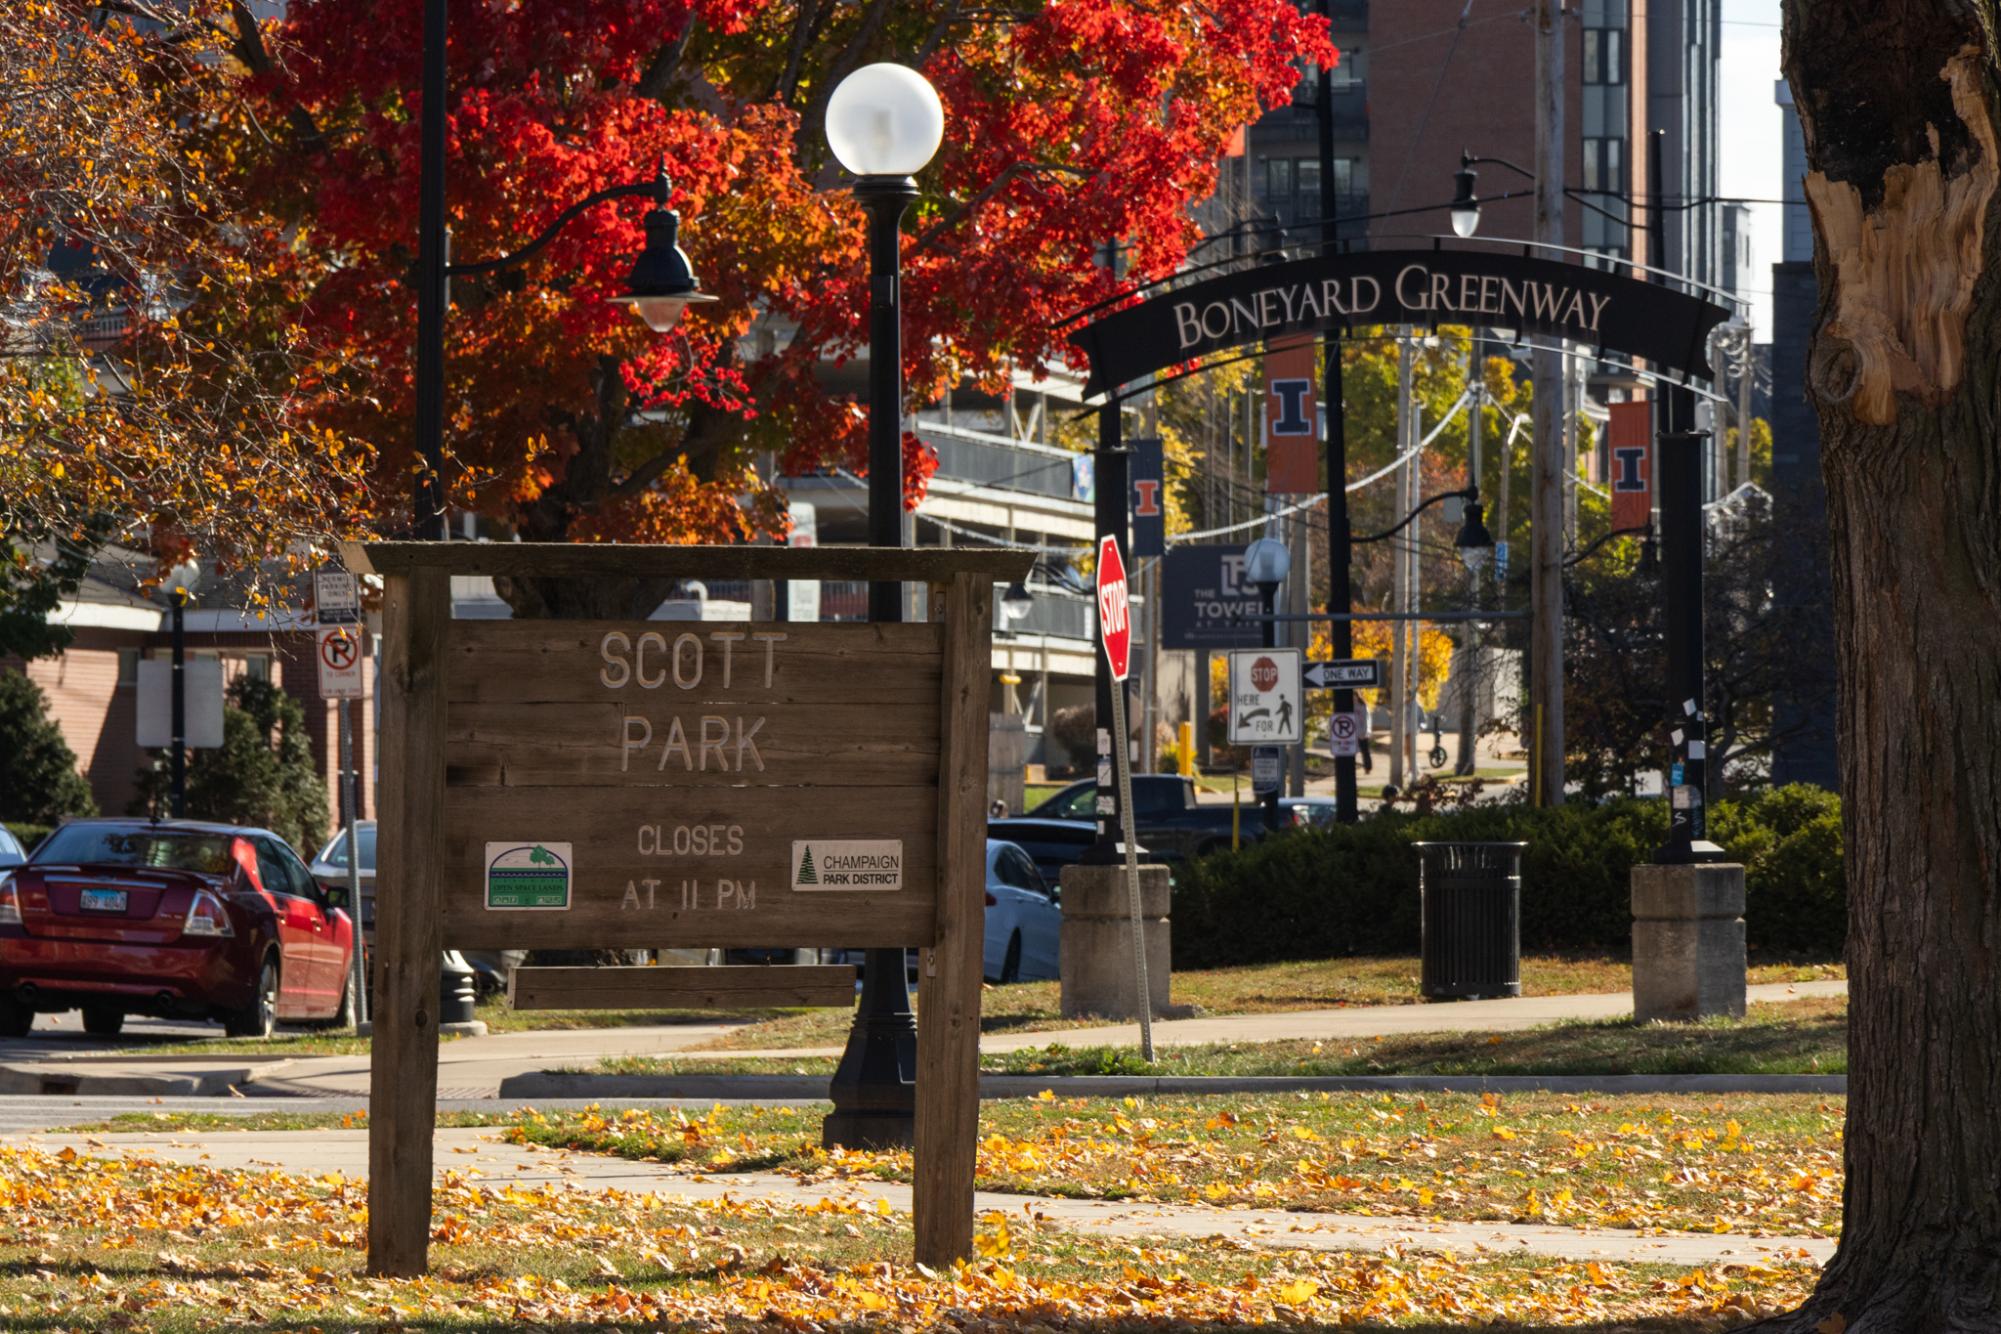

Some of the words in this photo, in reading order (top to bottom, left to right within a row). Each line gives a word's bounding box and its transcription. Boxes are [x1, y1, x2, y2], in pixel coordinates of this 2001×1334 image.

[1173, 276, 1381, 349] BONEYARD
[1395, 264, 1611, 332] GREENWAY
[1194, 589, 1215, 599] THE
[1101, 579, 1128, 636] STOP
[600, 631, 788, 690] SCOTT
[1251, 667, 1278, 682] STOP
[1323, 668, 1345, 680] ONE
[1347, 667, 1370, 679] WAY
[1236, 694, 1260, 706] HERE
[1255, 720, 1274, 732] FOR
[621, 715, 766, 772] PARK
[638, 824, 745, 856] CLOSES
[823, 855, 900, 869] CHAMPAIGN
[823, 873, 850, 885] PARK
[852, 873, 898, 885] DISTRICT
[620, 879, 662, 910] AT
[681, 879, 698, 910] 11
[716, 879, 756, 910] PM
